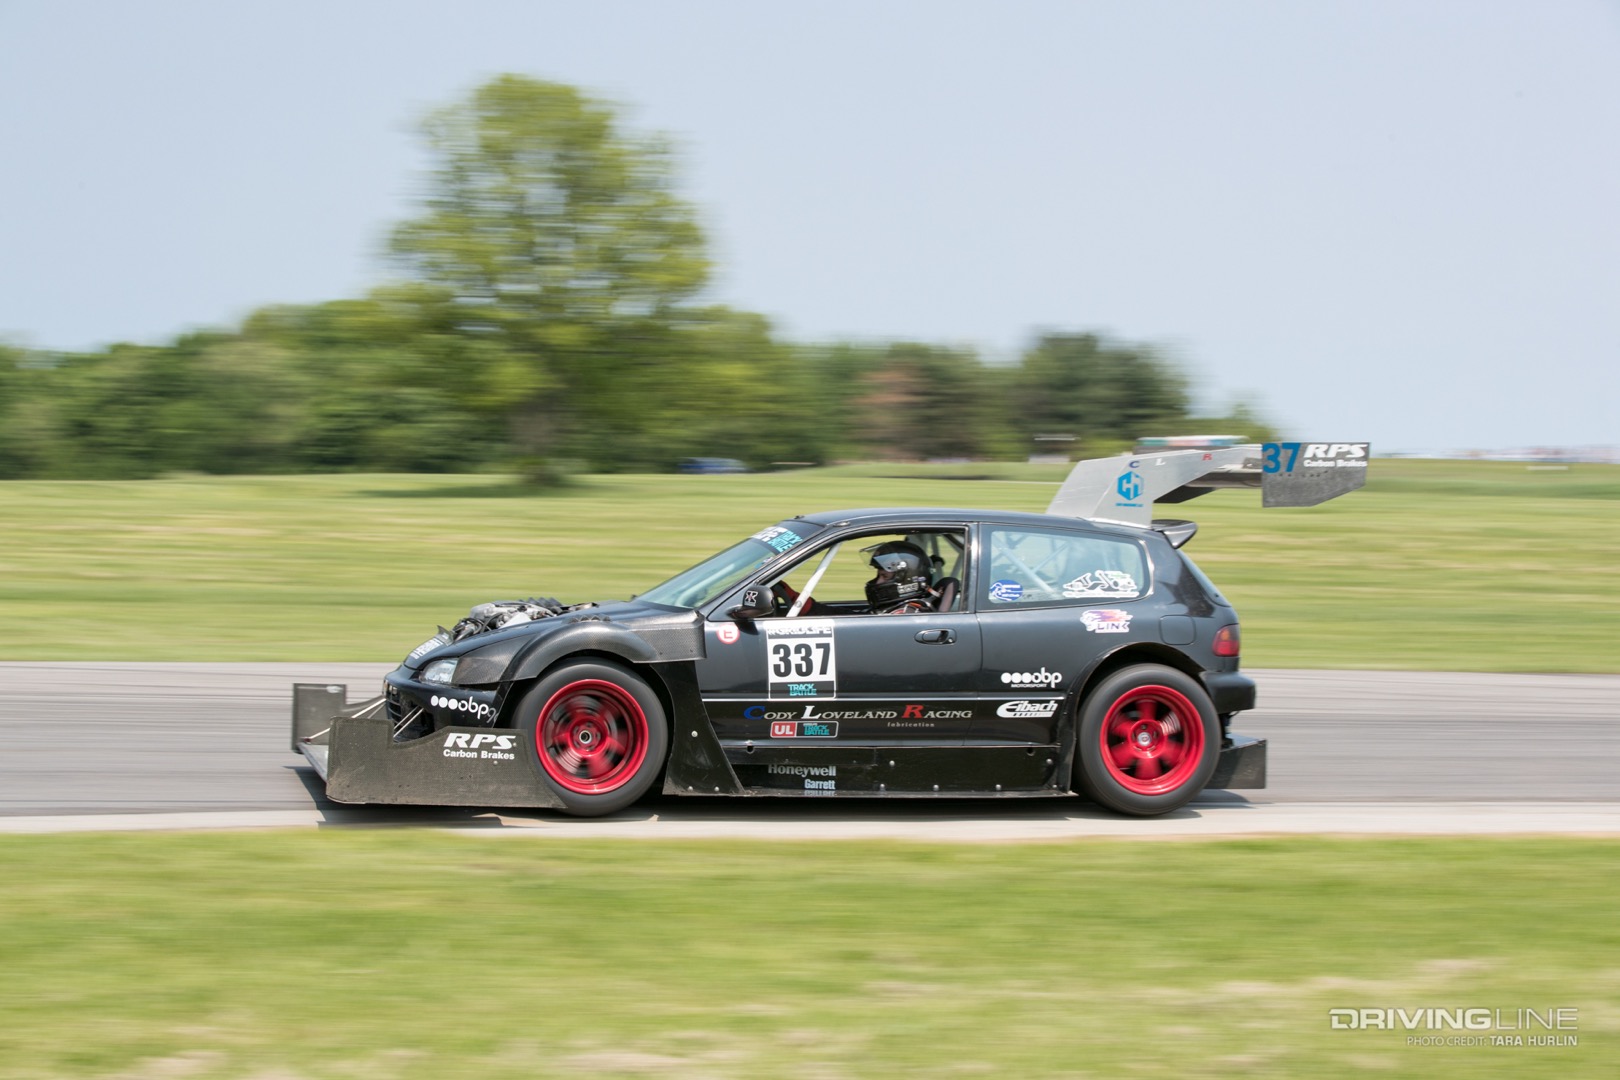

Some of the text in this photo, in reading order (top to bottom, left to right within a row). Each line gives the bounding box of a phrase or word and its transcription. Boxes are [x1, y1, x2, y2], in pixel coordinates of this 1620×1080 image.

[1262, 443, 1301, 473] 37
[1303, 444, 1368, 458] RPS
[1303, 459, 1368, 467] Carbon Brakes
[772, 642, 830, 678] 337
[787, 683, 815, 691] TRACK
[996, 700, 1058, 718] Eibach
[774, 725, 794, 735] UL
[443, 732, 516, 750] RPS
[442, 748, 515, 760] Carbon Brakes
[767, 764, 837, 778] Honeywell
[804, 779, 836, 790] Garrett
